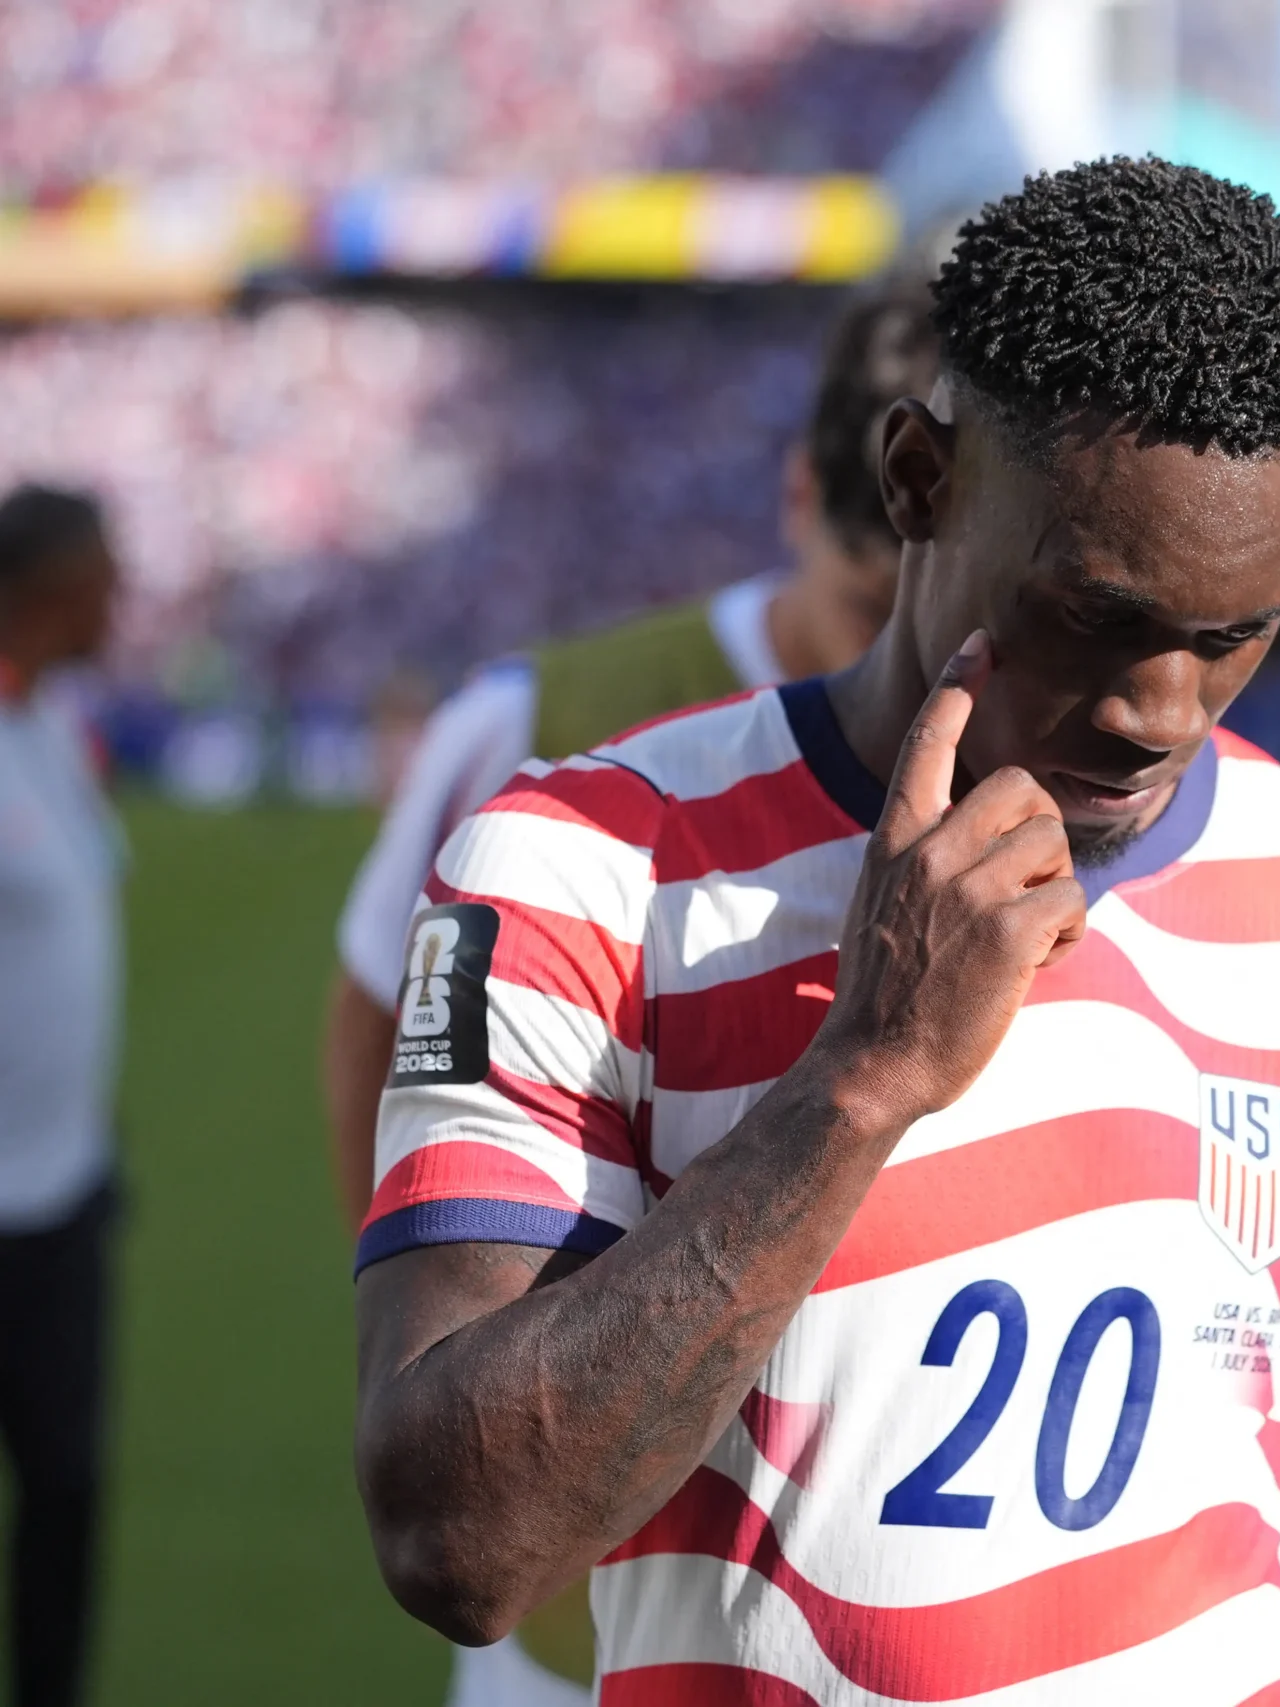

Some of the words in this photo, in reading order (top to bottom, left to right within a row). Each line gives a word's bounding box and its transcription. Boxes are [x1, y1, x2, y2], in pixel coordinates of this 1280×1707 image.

[413, 1012, 436, 1026] FIFA
[398, 1040, 430, 1053] WORLD
[431, 1039, 451, 1051] CUP
[396, 1053, 453, 1073] 2026
[1214, 1303, 1240, 1320] USA
[1192, 1325, 1236, 1345] SANTA
[1220, 1353, 1249, 1371] JULY
[879, 1279, 1161, 1531] 20
